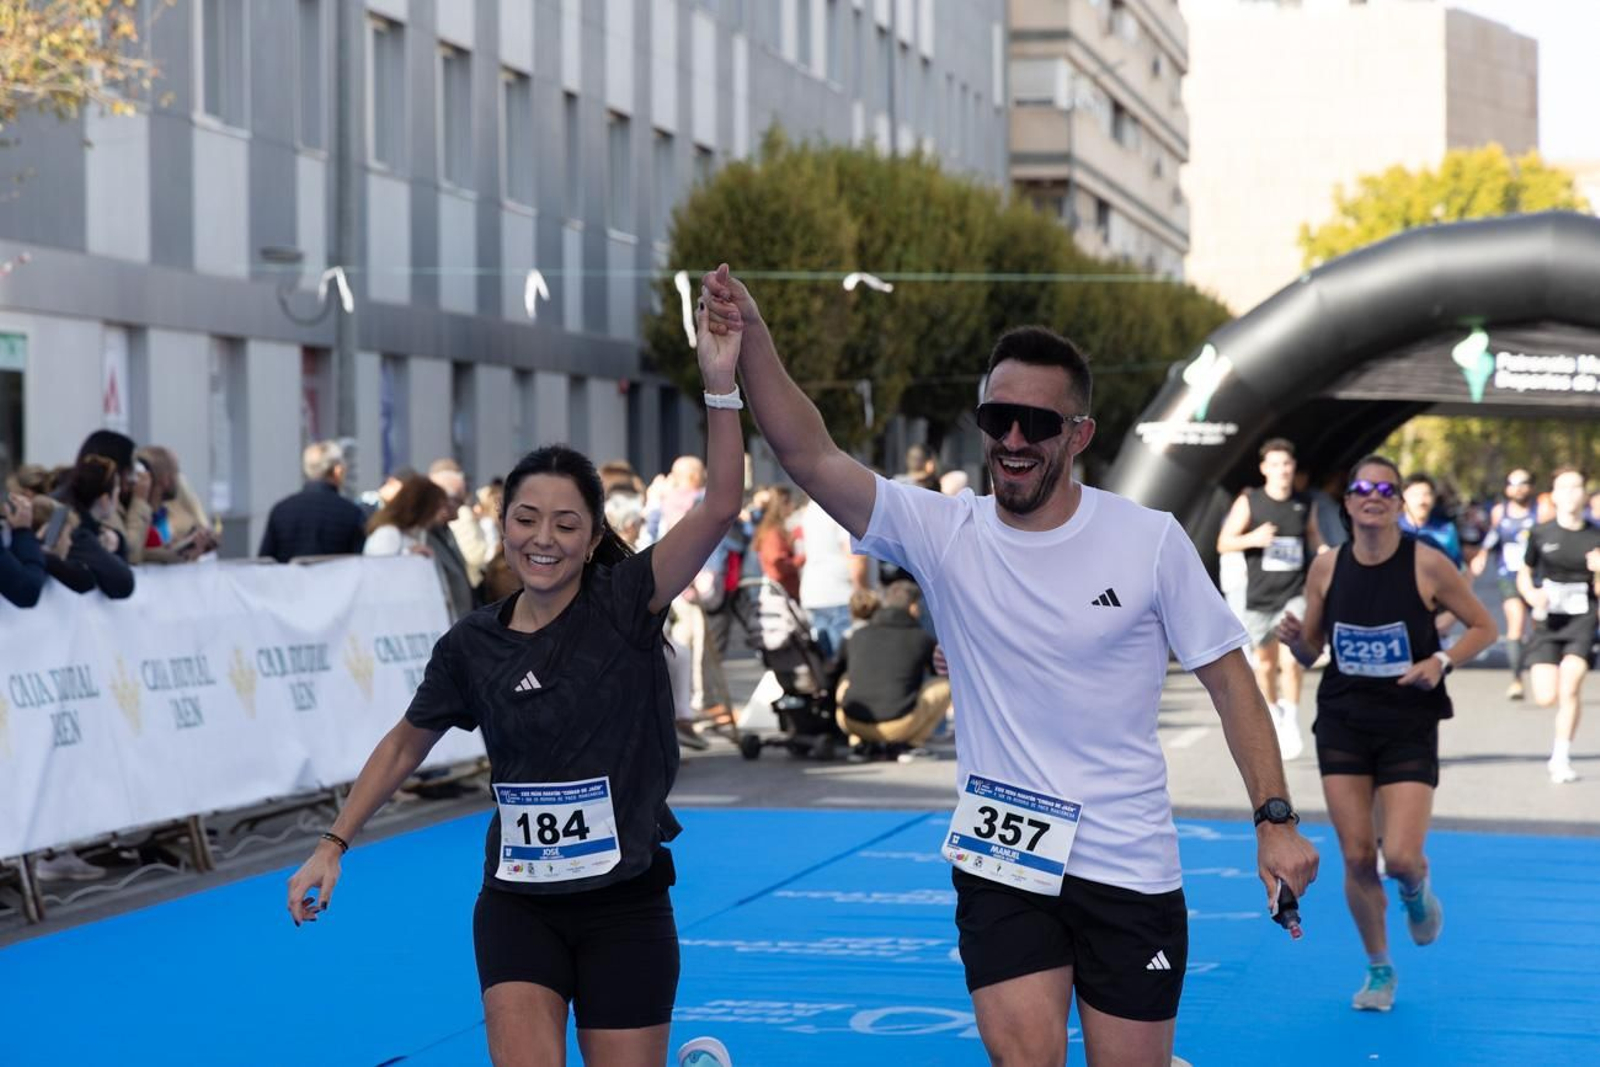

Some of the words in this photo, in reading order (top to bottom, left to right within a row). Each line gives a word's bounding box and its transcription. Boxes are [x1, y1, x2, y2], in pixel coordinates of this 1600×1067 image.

[1340, 639, 1402, 659] 2291
[517, 809, 590, 845] 184
[974, 806, 1051, 852] 357
[542, 846, 560, 856] JOSÉ
[990, 845, 1020, 860] MANUEL
